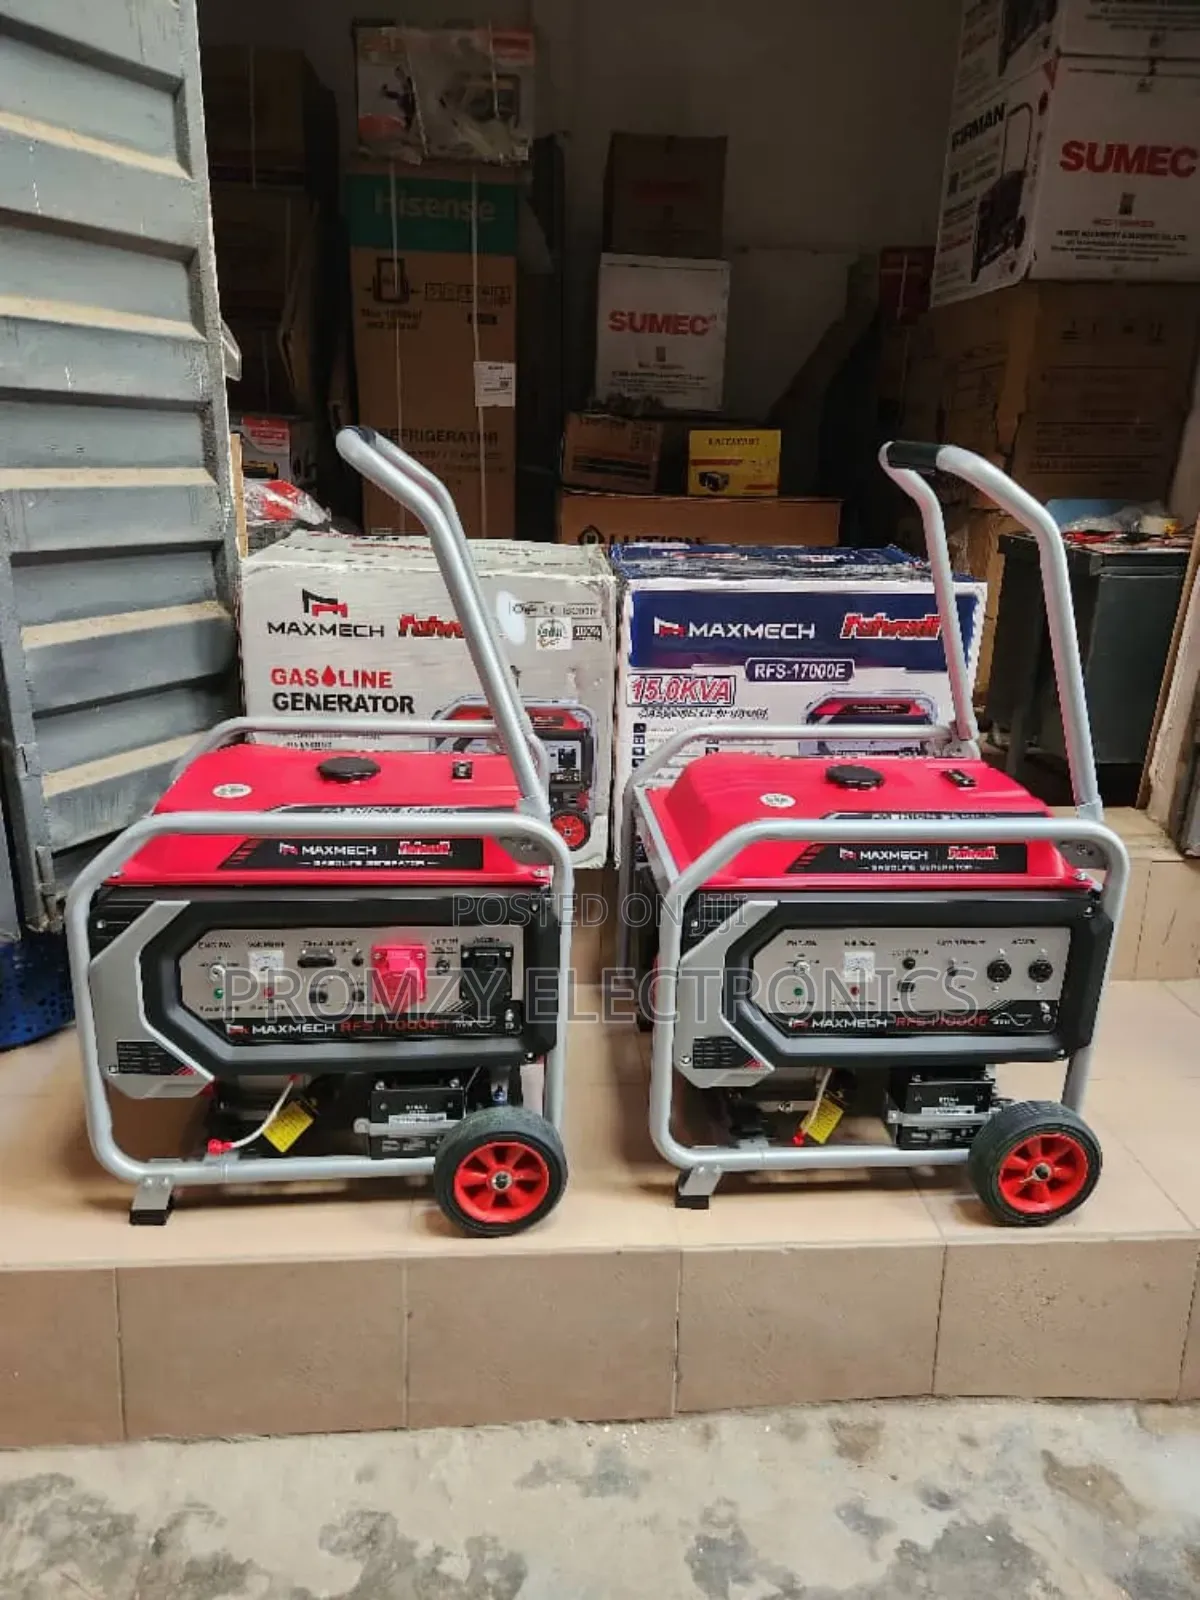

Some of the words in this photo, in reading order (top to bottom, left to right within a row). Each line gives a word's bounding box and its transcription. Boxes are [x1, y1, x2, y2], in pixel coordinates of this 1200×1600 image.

[1059, 140, 1197, 178] SUMEC
[374, 189, 497, 222] Hisense
[609, 310, 710, 336] SUMEC
[267, 622, 384, 638] MAXMECH
[688, 623, 815, 640] MAXMECH
[754, 661, 845, 679] RFS-17000E
[631, 676, 732, 703] 15.0KVA
[272, 693, 415, 714] GENERATOR
[302, 845, 377, 856] MAXMECH
[860, 850, 928, 860] MAXMECH
[252, 1023, 336, 1034] MAXMECH
[811, 1018, 888, 1029] MAXMECH
